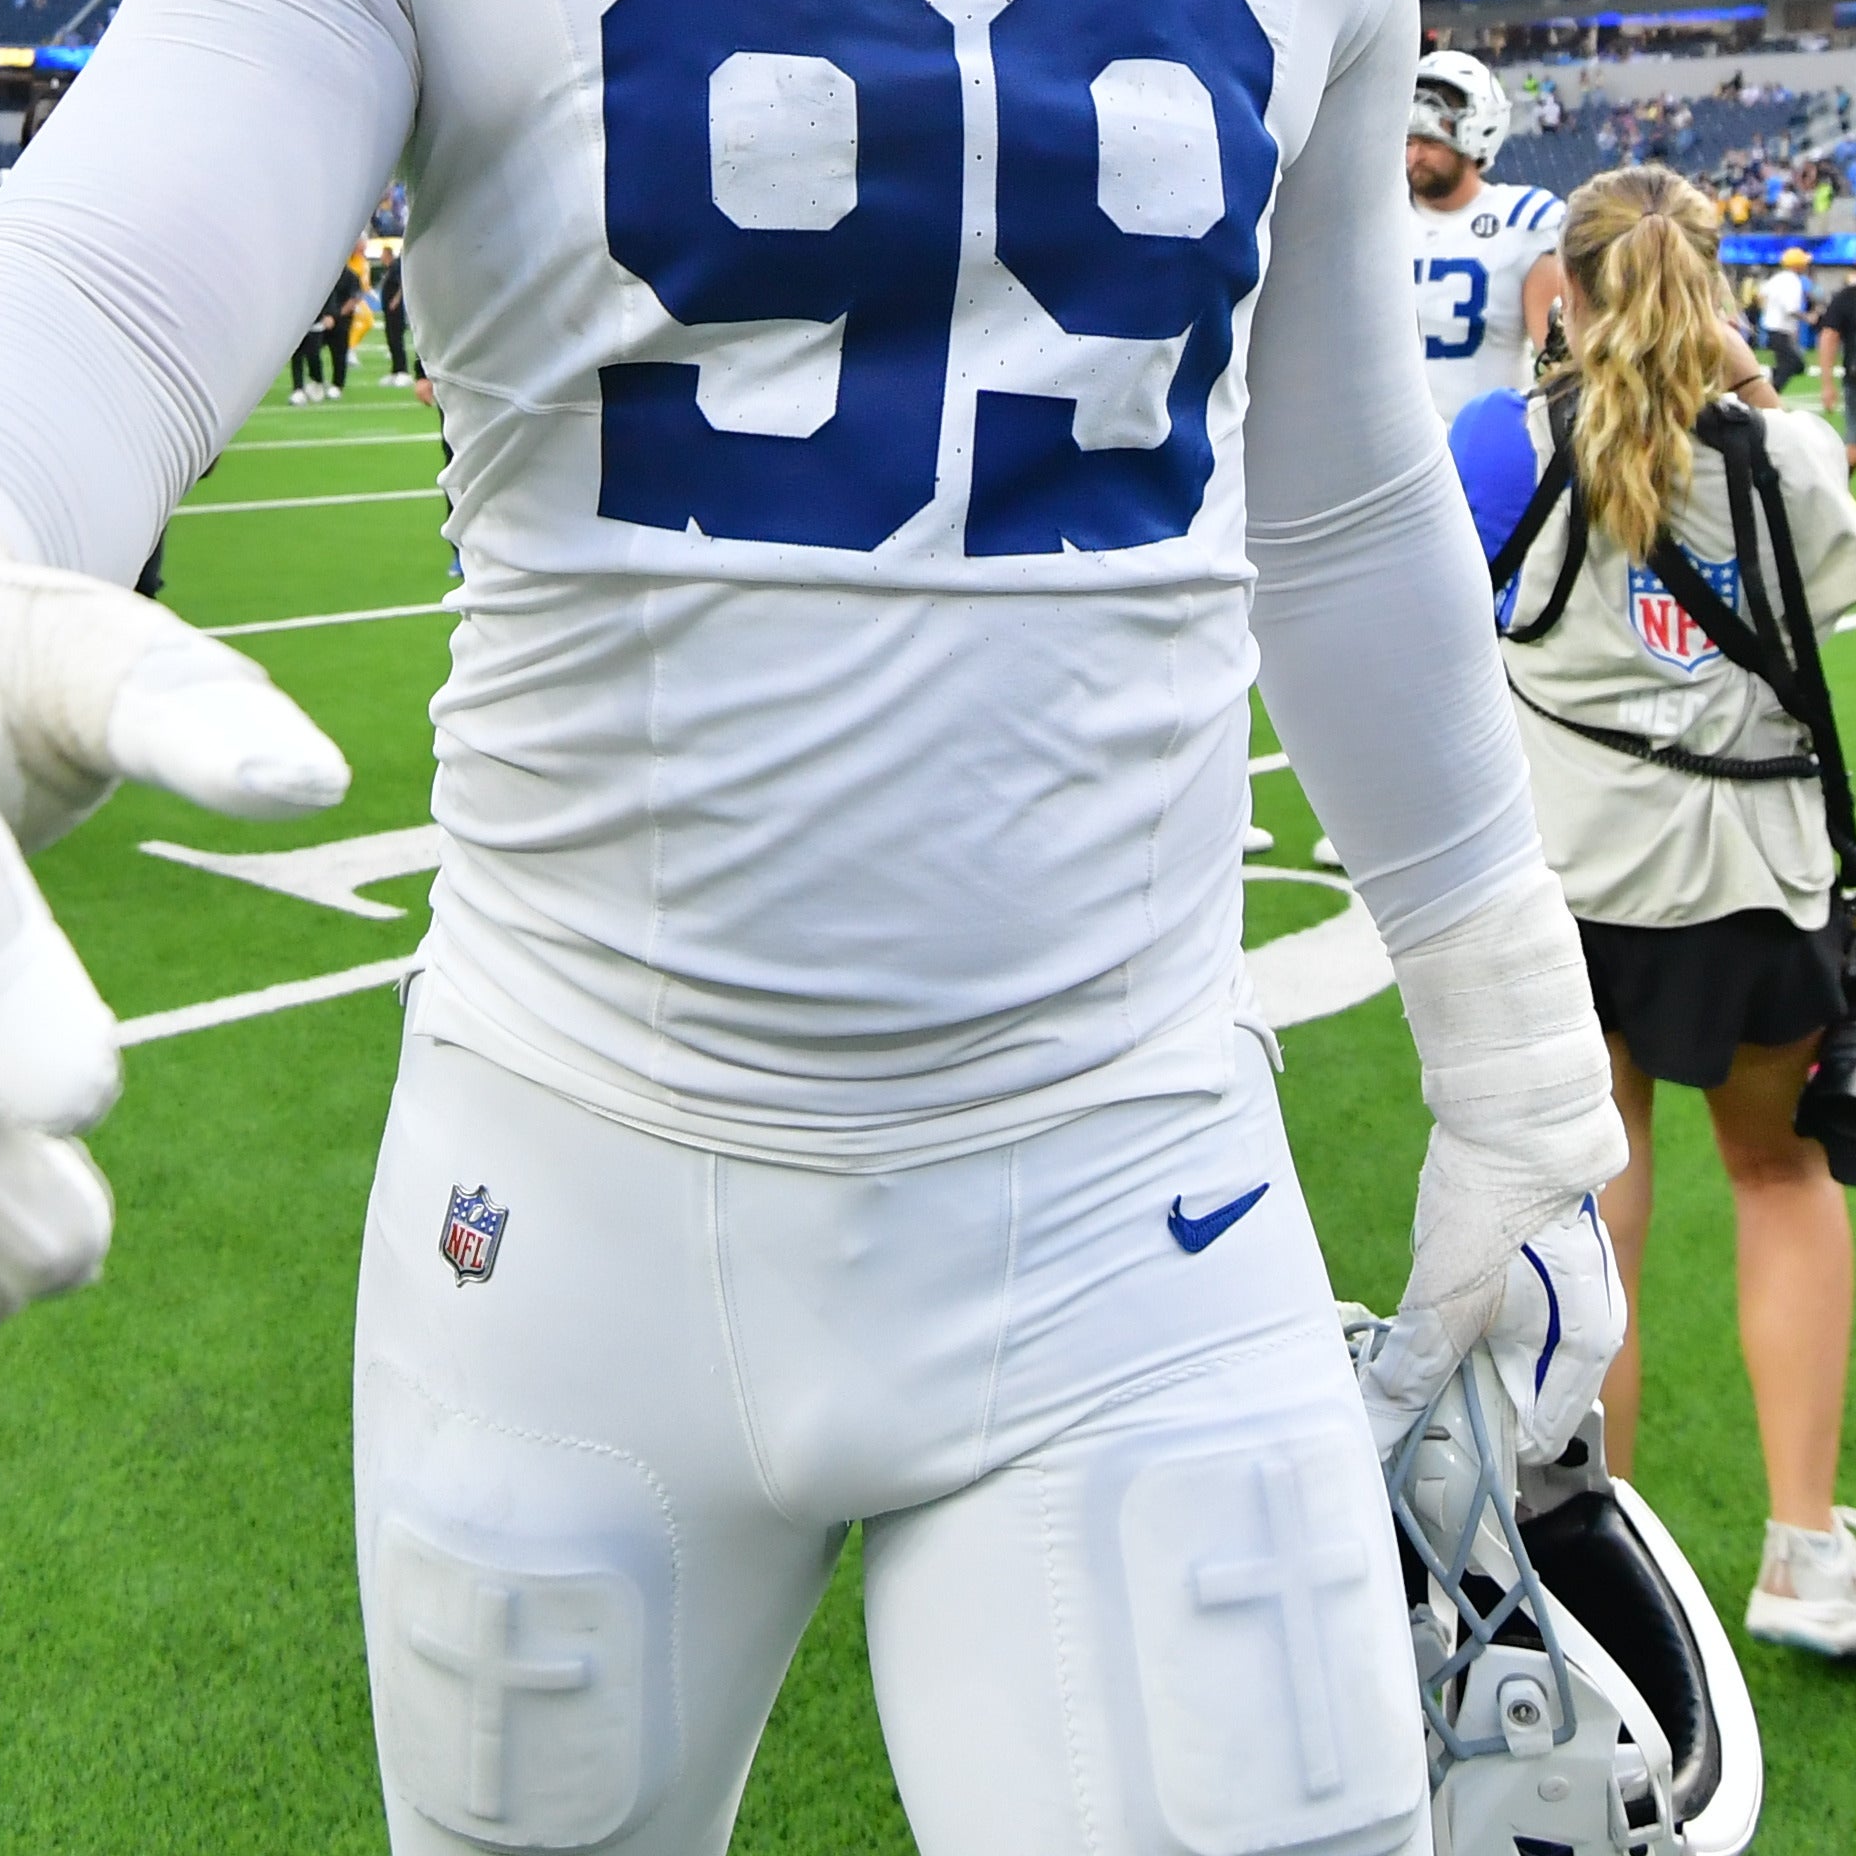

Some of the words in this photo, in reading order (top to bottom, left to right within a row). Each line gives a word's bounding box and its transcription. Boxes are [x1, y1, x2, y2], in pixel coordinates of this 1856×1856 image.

[1413, 257, 1490, 360] 3
[1639, 597, 1719, 657] NF
[446, 1222, 484, 1269] NFL
